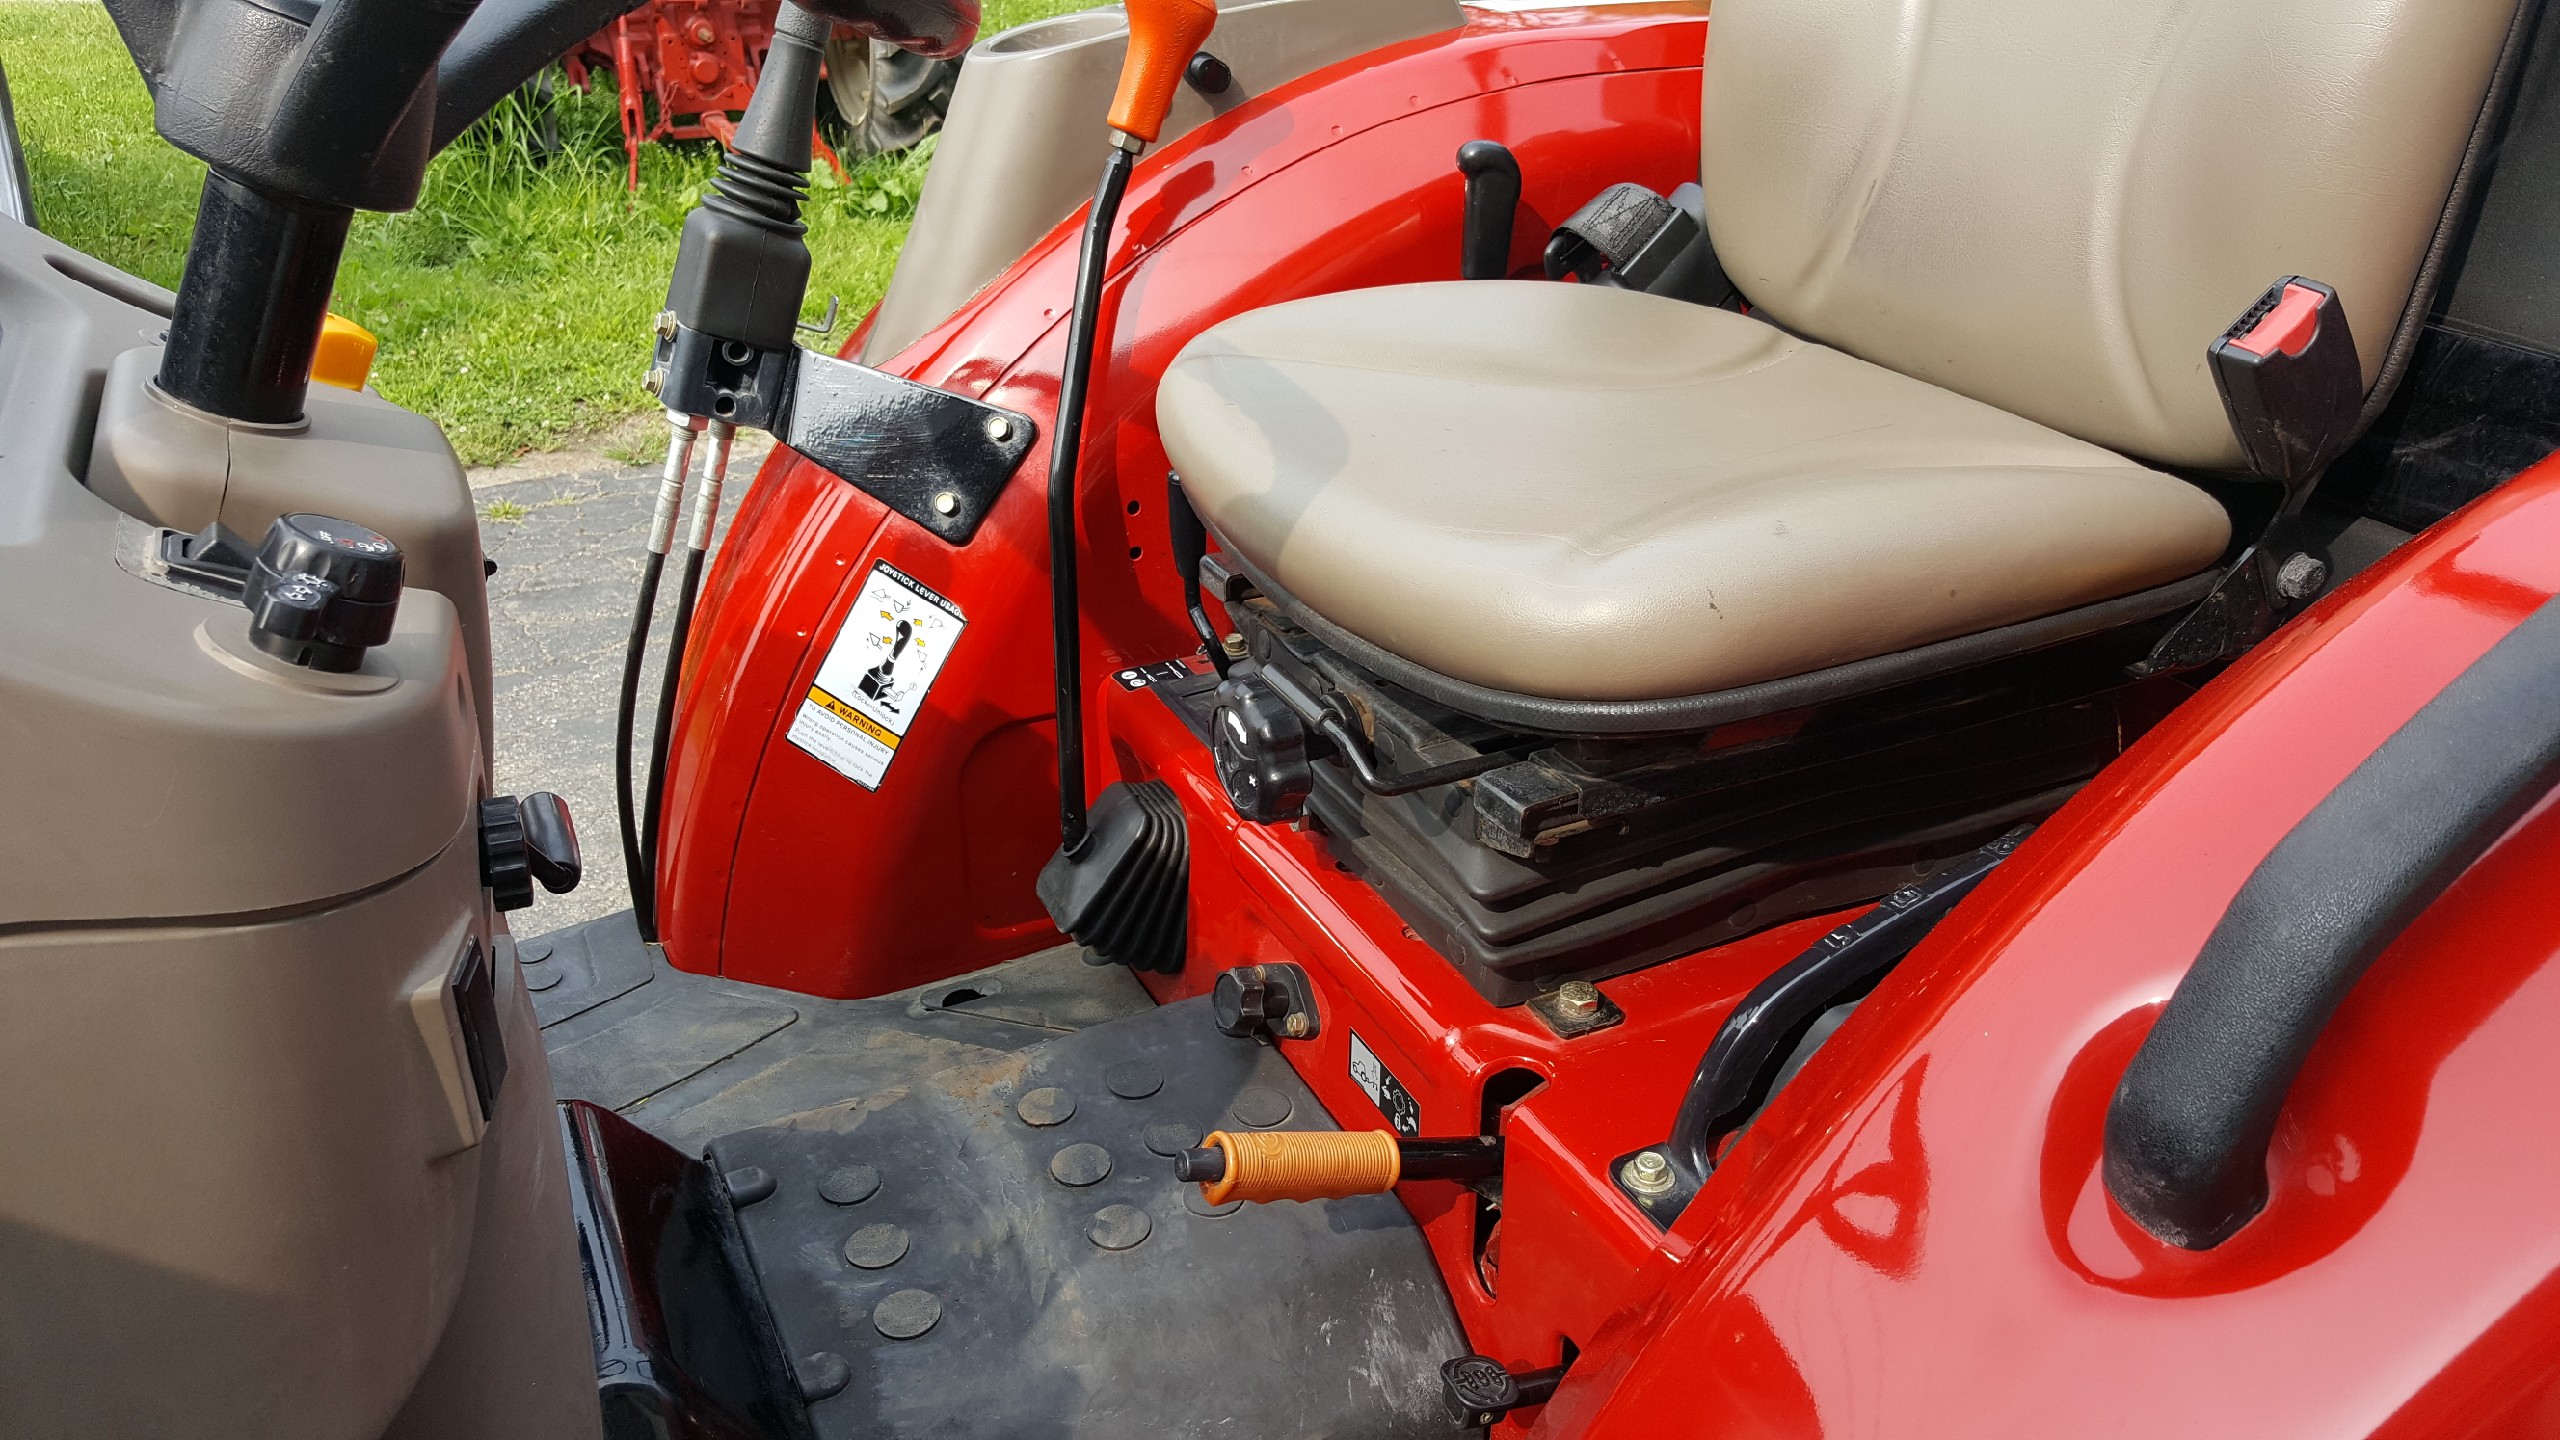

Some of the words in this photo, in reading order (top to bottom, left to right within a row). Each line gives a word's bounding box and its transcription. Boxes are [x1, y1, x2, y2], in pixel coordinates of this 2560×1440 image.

[879, 563, 916, 588] JOYSTICK
[915, 584, 940, 603] LEVER
[939, 599, 961, 617] USAG
[816, 709, 836, 723] AVOID
[836, 720, 867, 743] PERSONAL
[867, 740, 889, 755] INJURY
[840, 706, 882, 737] WARNING
